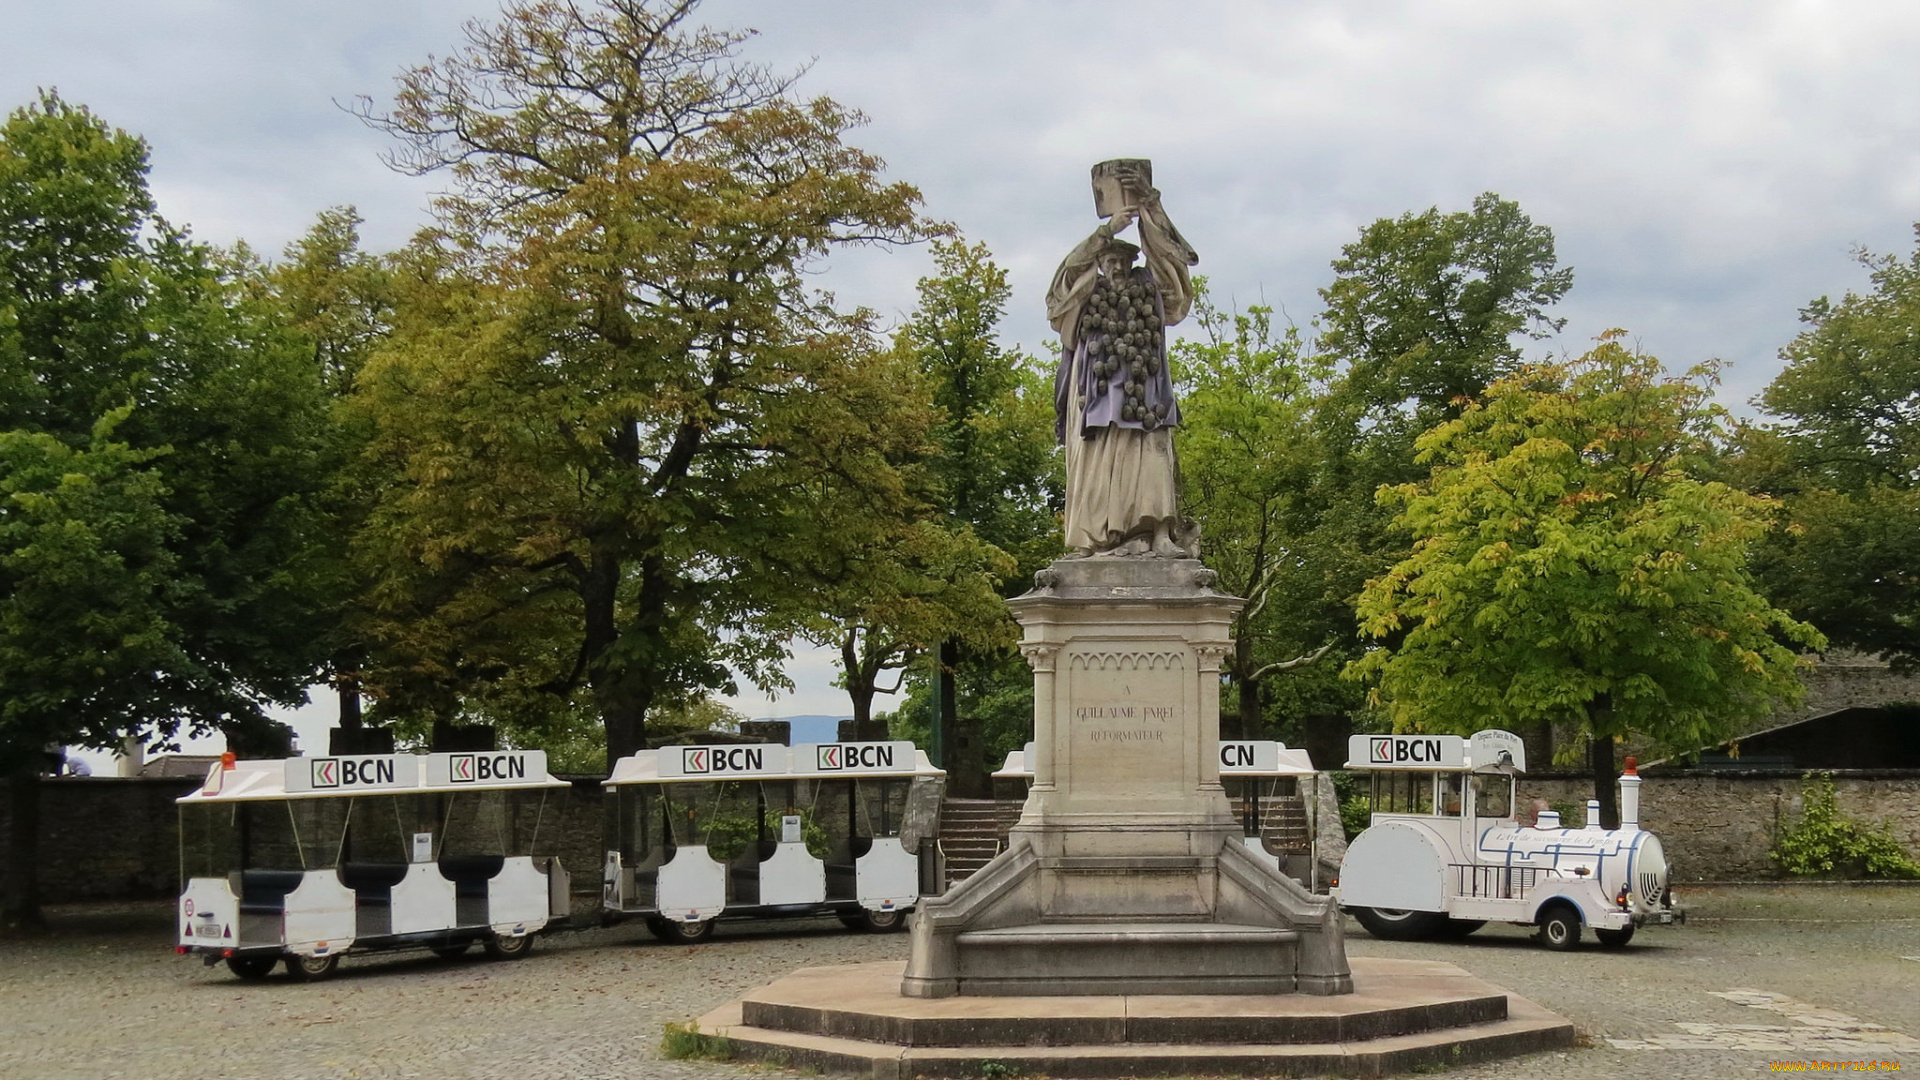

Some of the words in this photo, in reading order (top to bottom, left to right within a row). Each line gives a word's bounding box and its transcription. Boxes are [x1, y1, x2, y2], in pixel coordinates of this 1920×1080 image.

[1076, 706, 1138, 721] GUILLAUME
[1143, 706, 1175, 723] FAREL
[712, 748, 763, 771] BCN
[844, 745, 893, 768] BCN
[1220, 745, 1254, 766] CN
[1395, 739, 1441, 762] BCN
[342, 758, 394, 785] BCN
[477, 754, 525, 779] BCN
